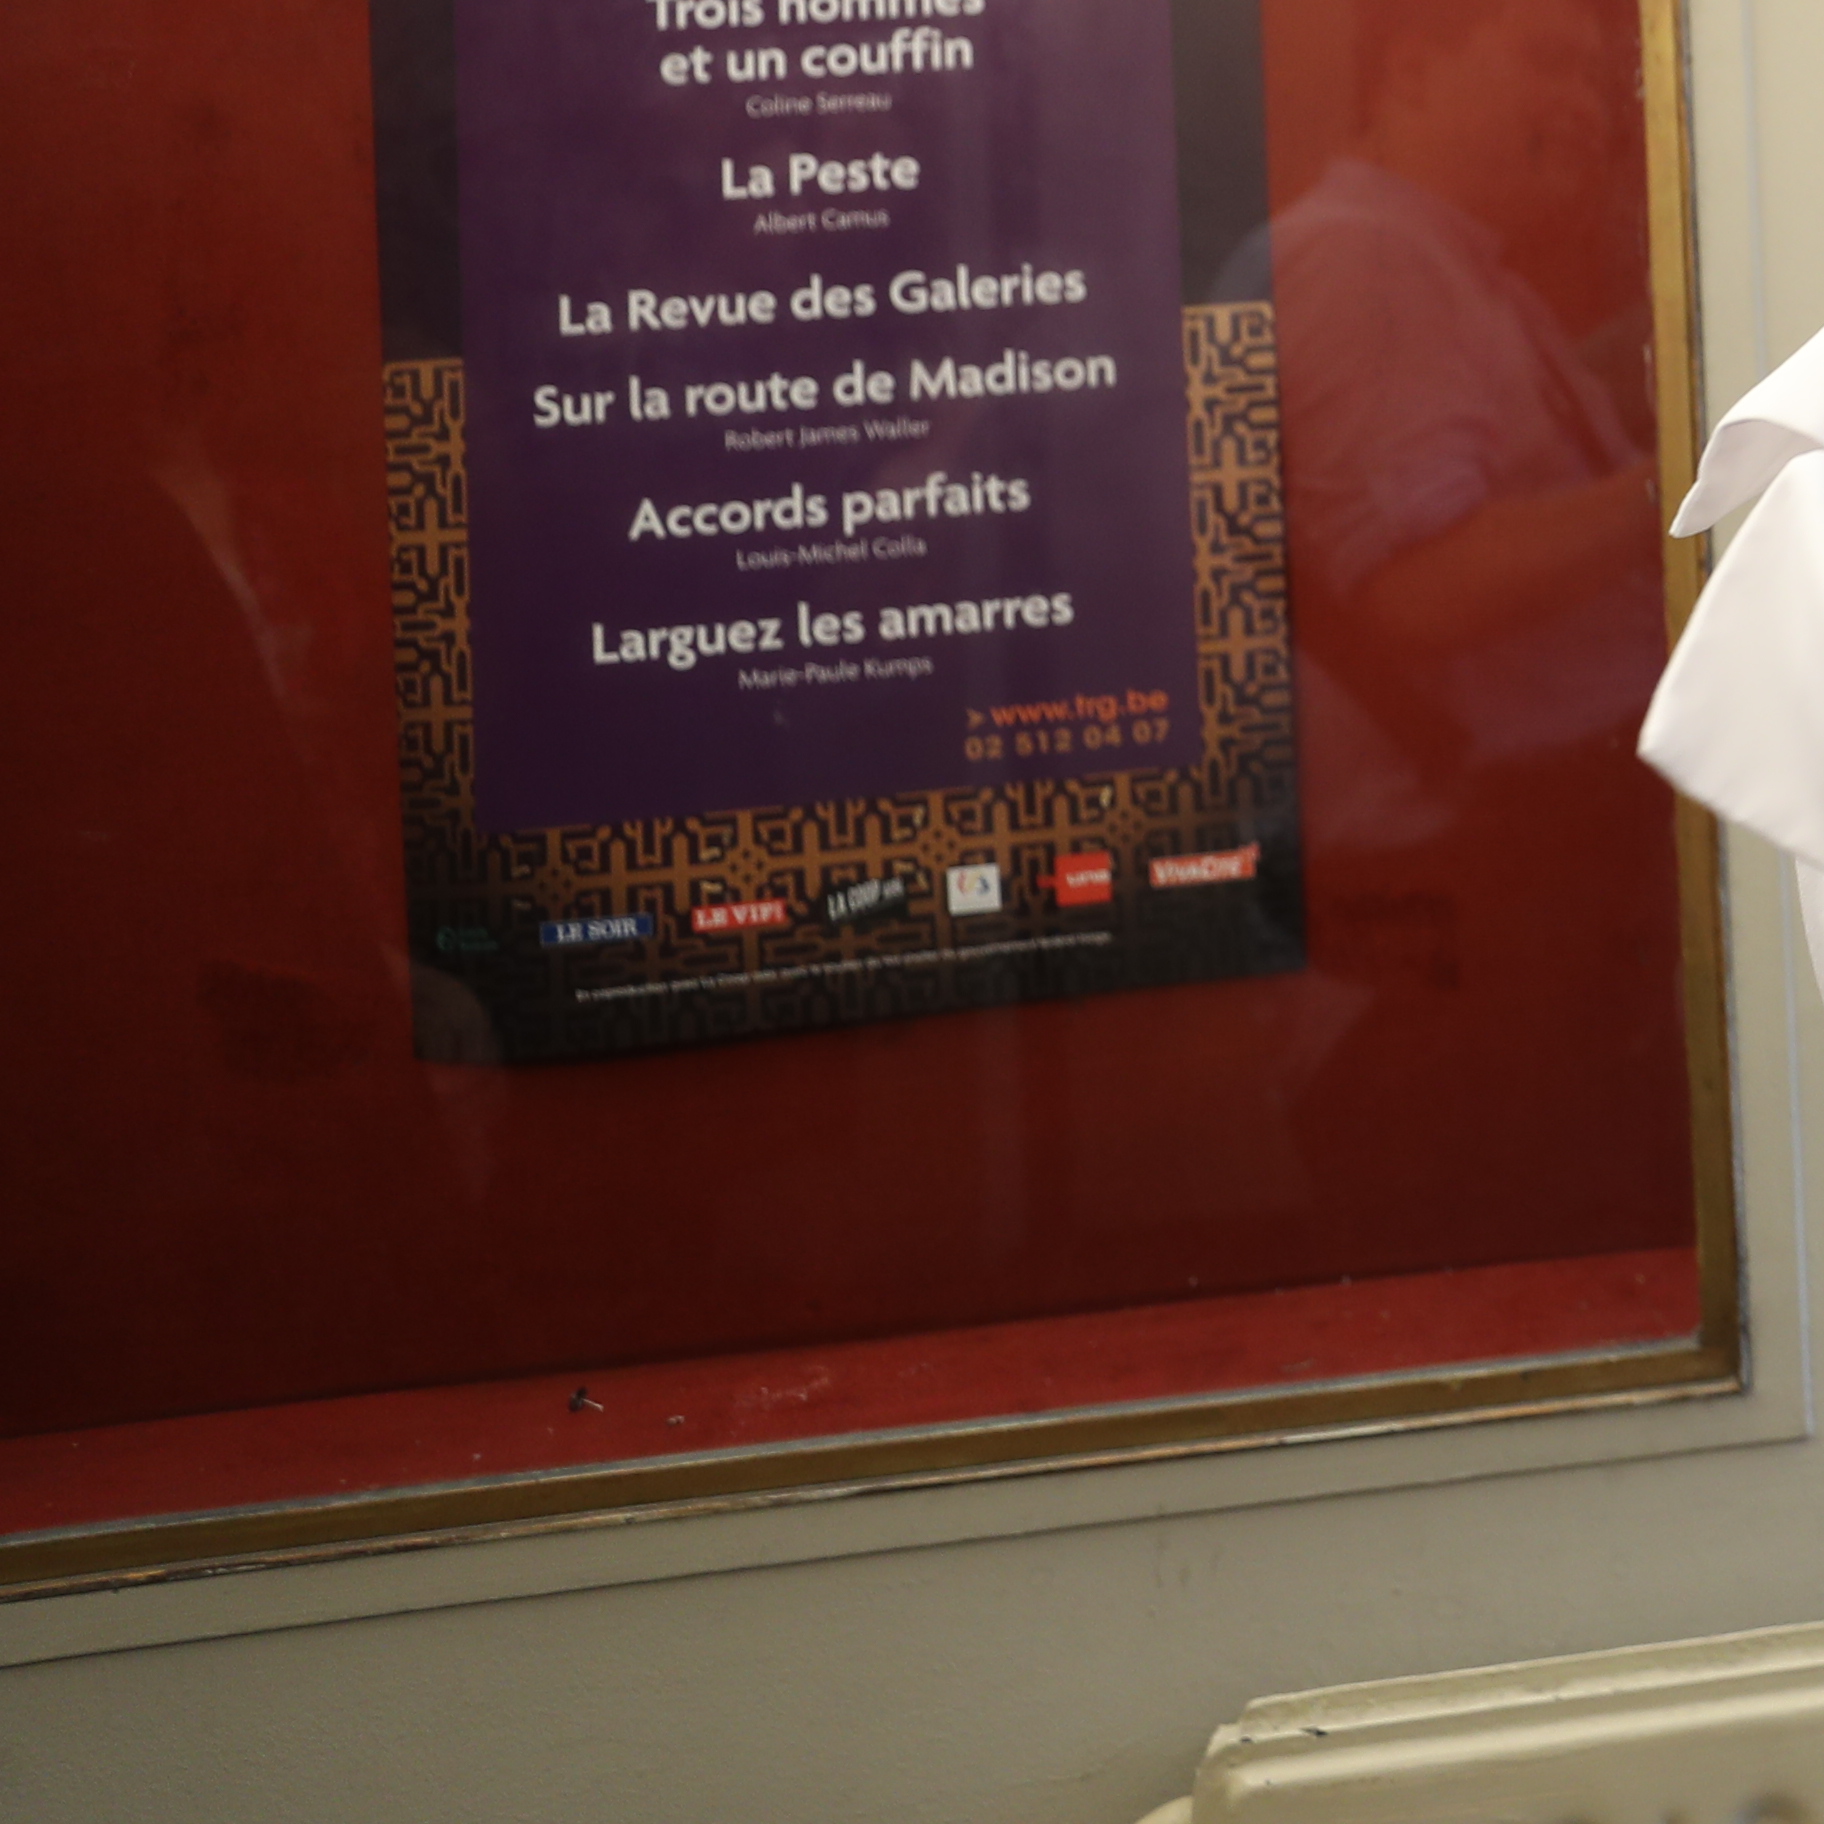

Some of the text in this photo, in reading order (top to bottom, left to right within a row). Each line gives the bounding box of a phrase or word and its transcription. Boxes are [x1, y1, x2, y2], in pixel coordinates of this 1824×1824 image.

[659, 26, 975, 86] et un couffin
[720, 150, 921, 200] La Peste
[558, 261, 1088, 338] La Revue des Galeries
[532, 348, 1118, 430] Sur la route de Madison
[628, 472, 1033, 547] Accords parfaits
[592, 588, 1076, 672] Larguez les amarres
[587, 917, 637, 940] SOIR
